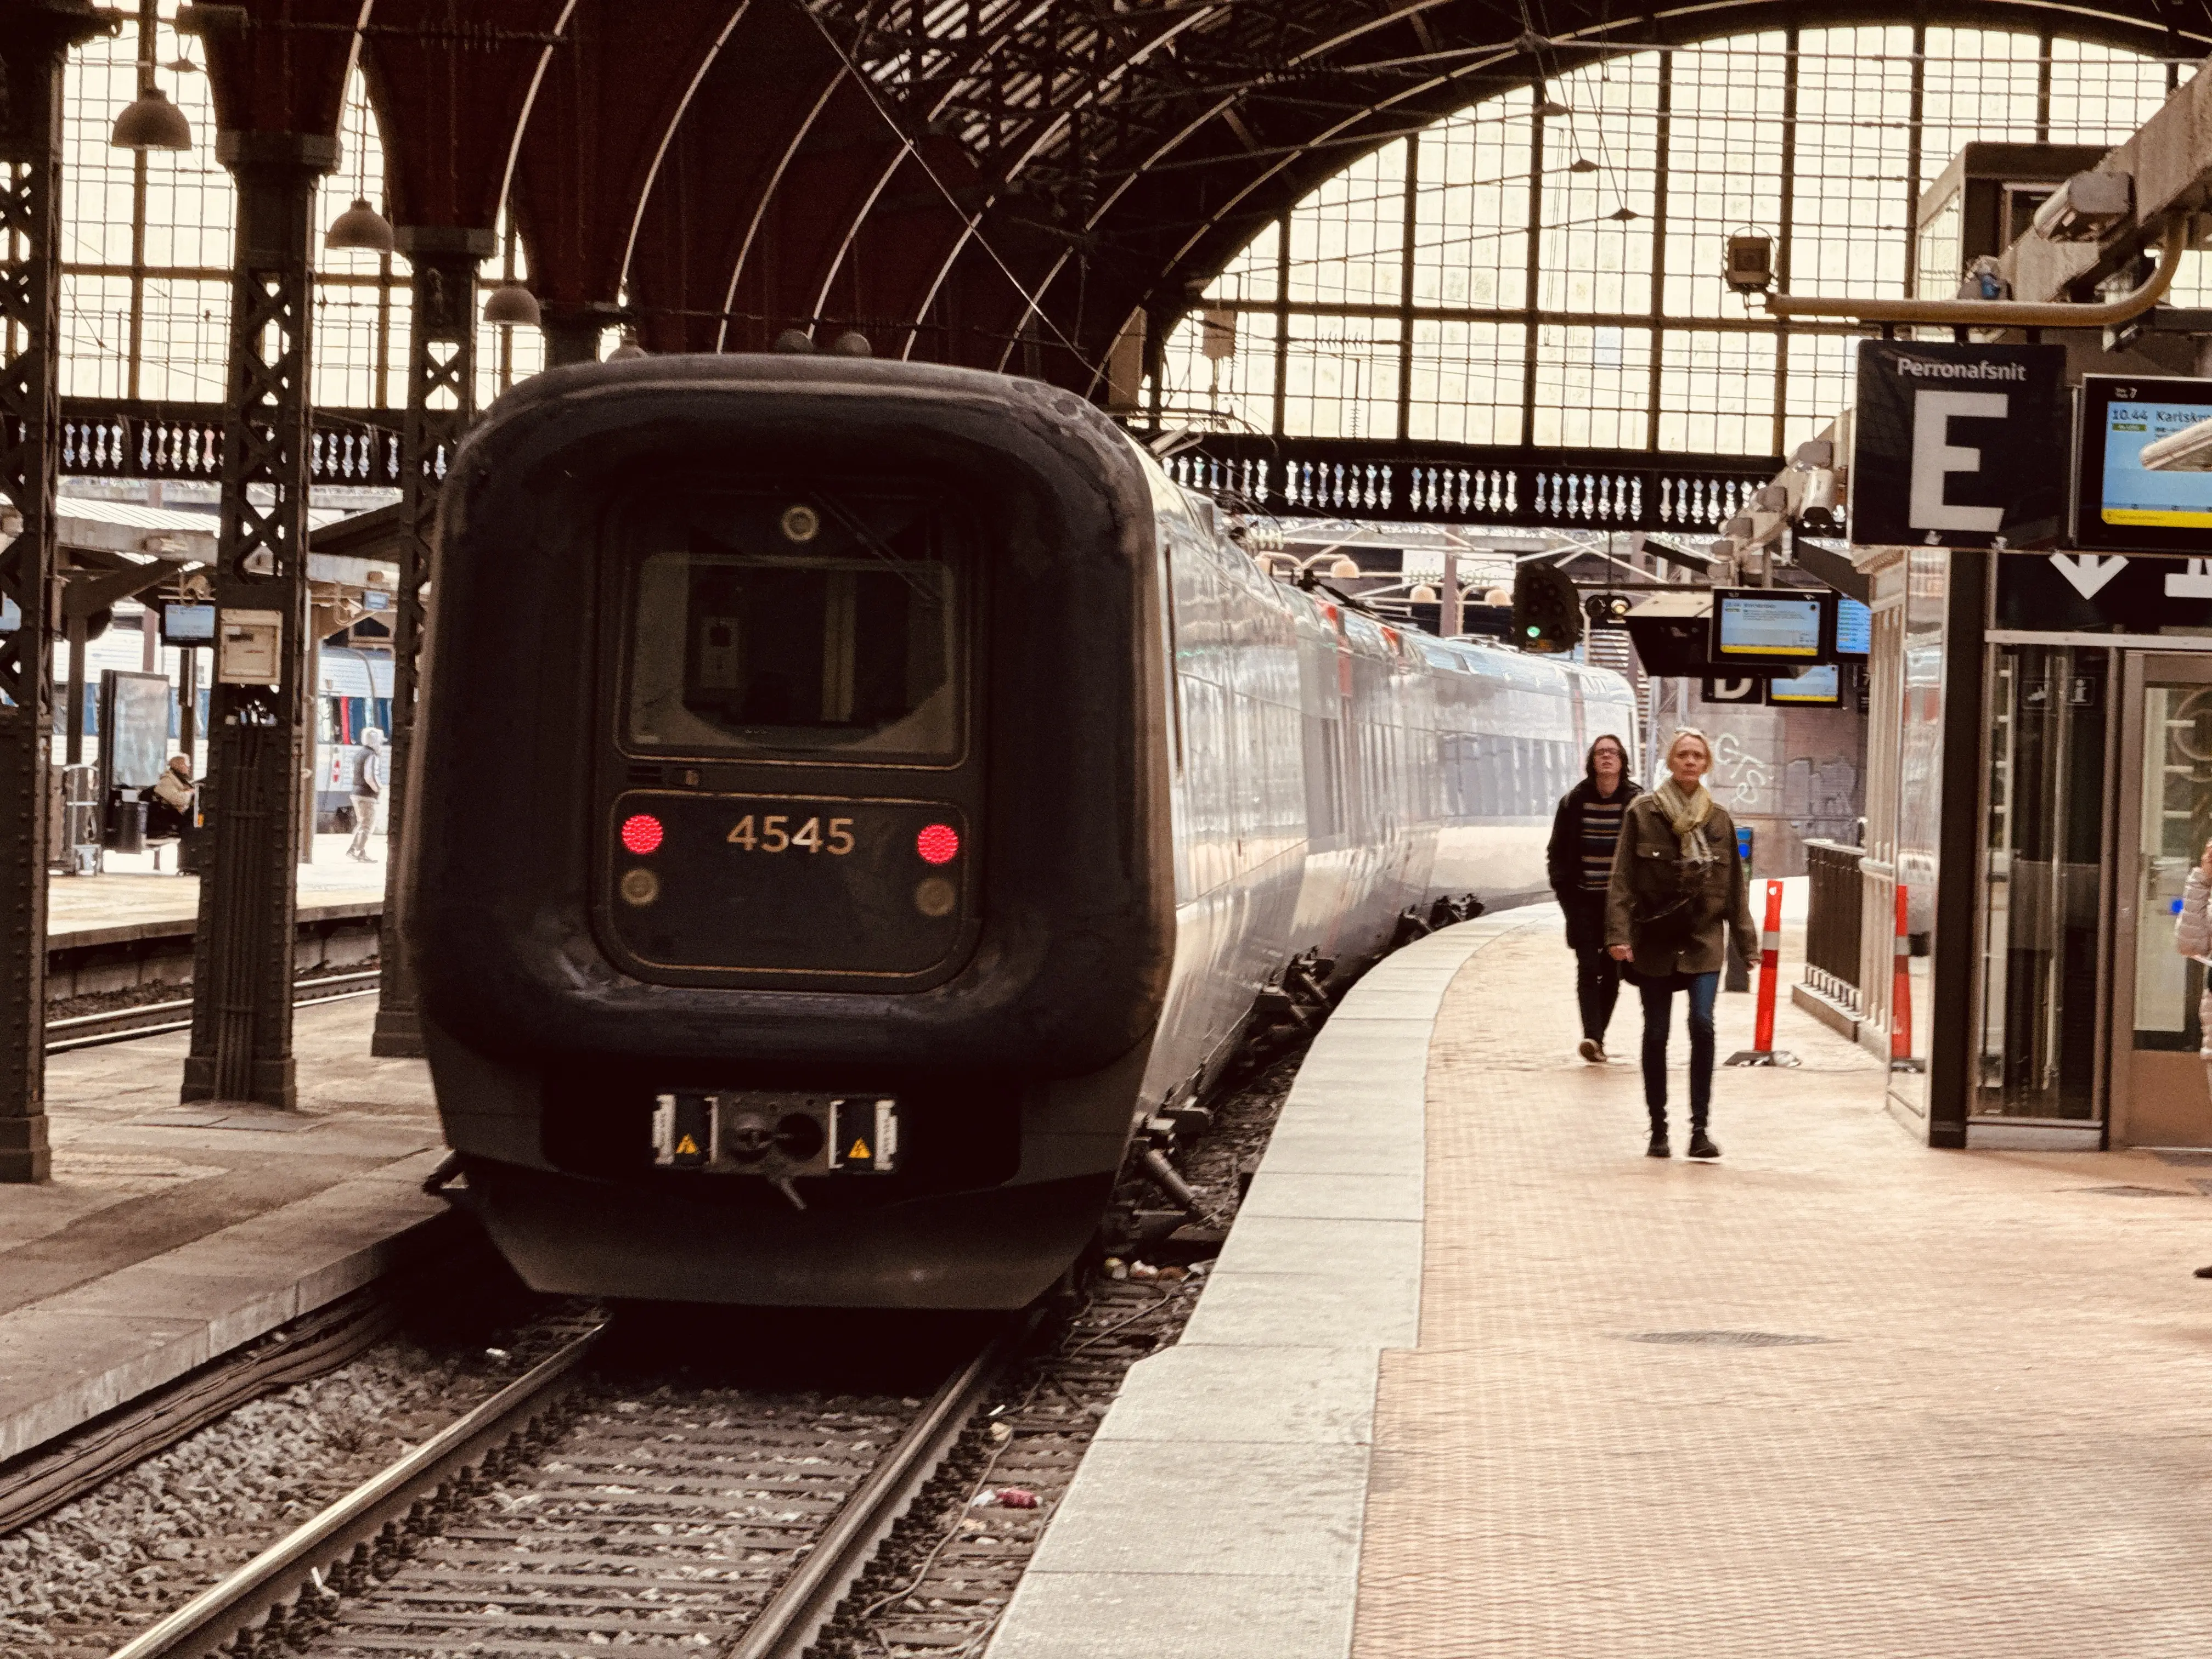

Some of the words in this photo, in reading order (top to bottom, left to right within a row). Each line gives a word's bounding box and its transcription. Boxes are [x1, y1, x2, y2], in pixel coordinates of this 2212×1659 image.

[1897, 357, 2027, 381] Perronafsnit
[2112, 408, 2148, 421] 10.44
[1909, 389, 2009, 532] E
[726, 814, 856, 855] 4545
